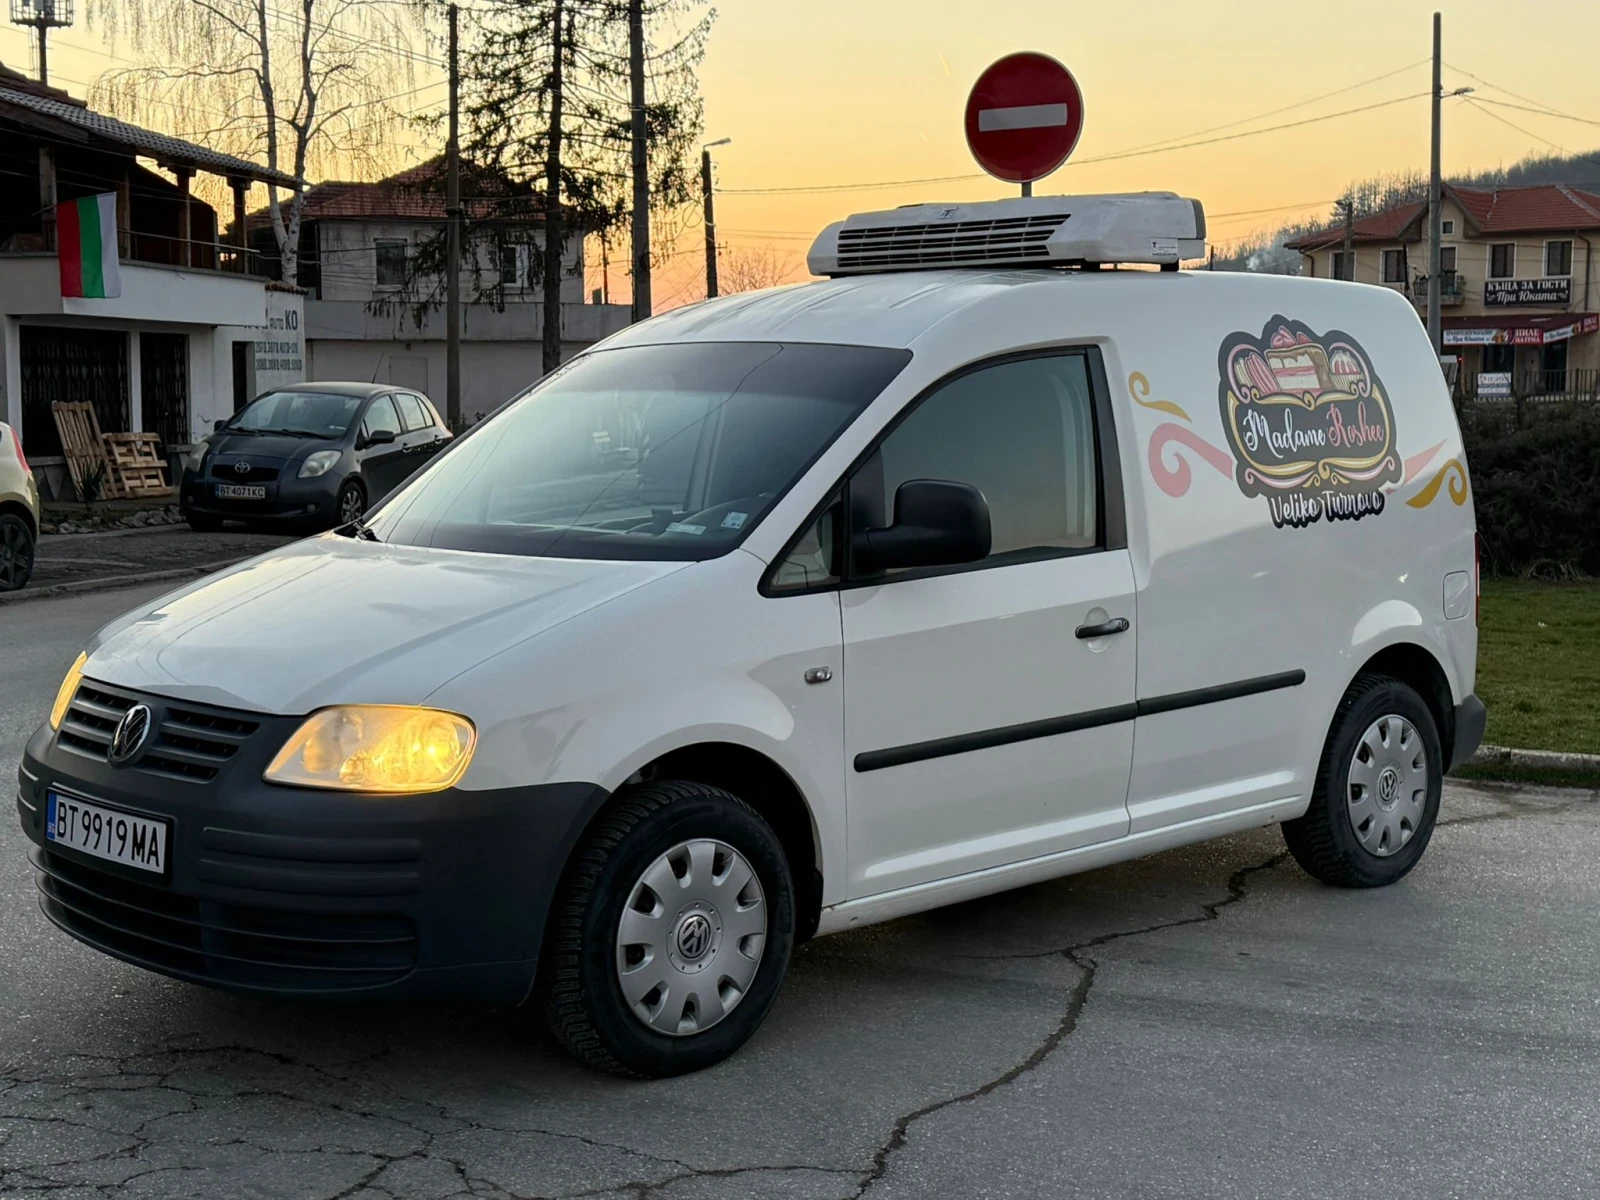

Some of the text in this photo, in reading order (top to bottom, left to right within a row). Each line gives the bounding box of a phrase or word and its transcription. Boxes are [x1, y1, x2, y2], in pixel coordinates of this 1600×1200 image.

[1487, 279, 1567, 291] КЪЩА ЗА ГОСТИ
[1496, 290, 1557, 304] При Юката
[1243, 401, 1384, 458] Madame Roshee
[1271, 490, 1382, 523] Veliko Turnovo
